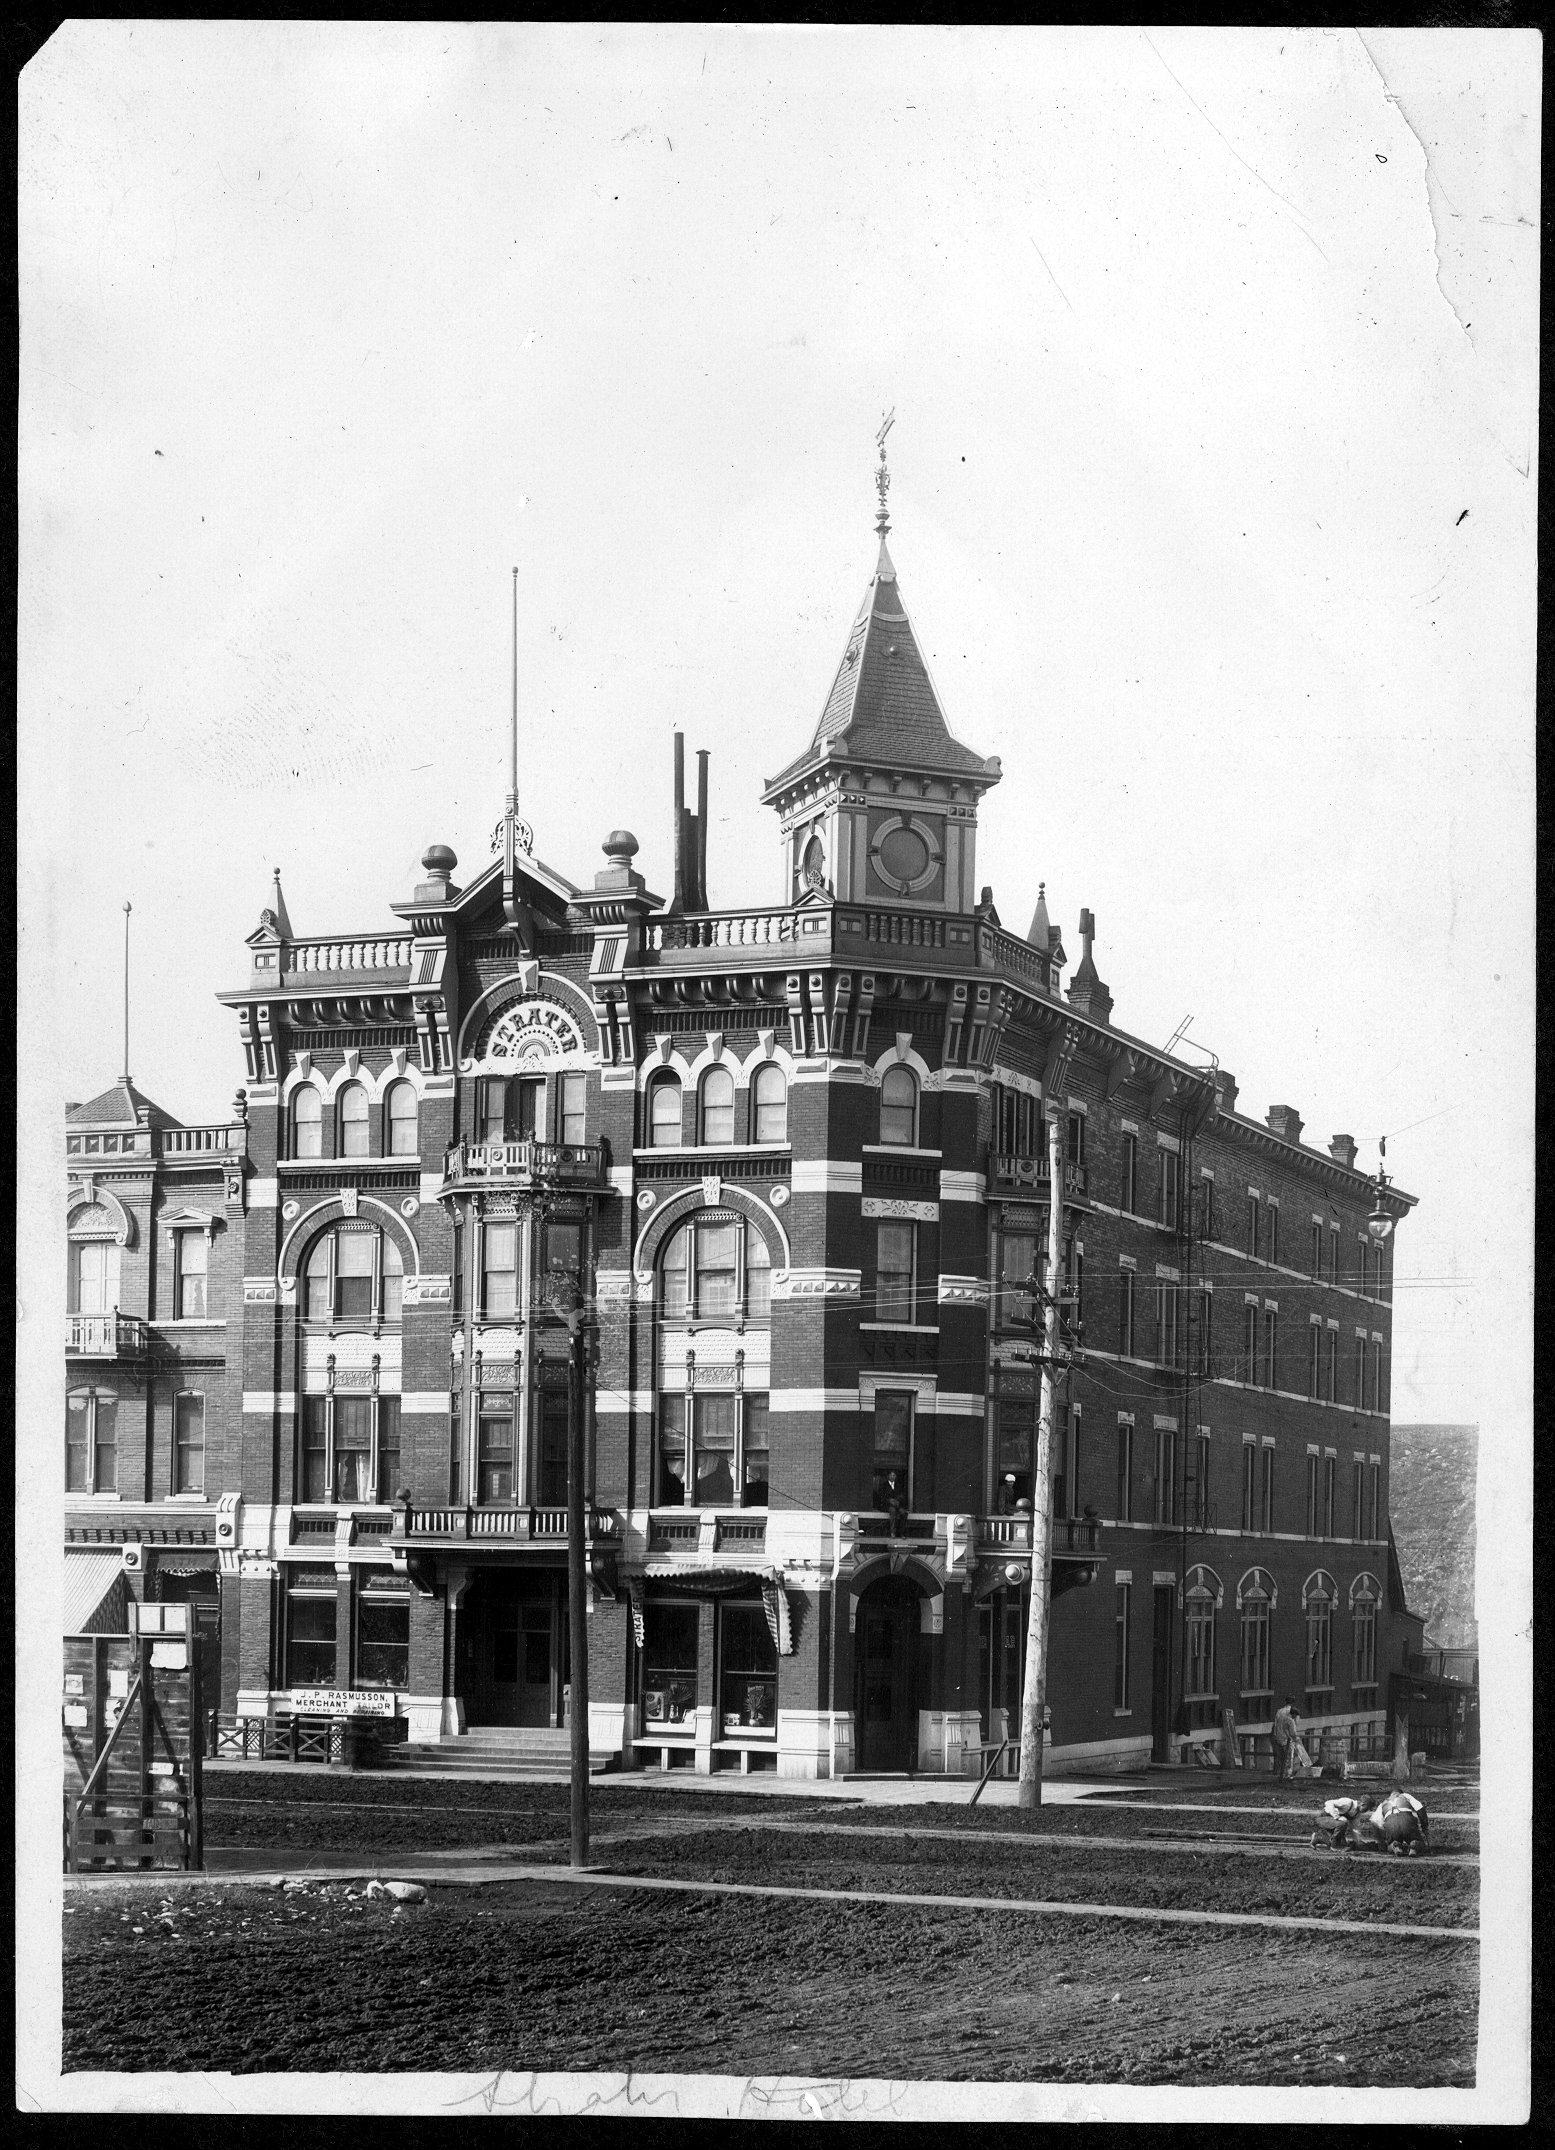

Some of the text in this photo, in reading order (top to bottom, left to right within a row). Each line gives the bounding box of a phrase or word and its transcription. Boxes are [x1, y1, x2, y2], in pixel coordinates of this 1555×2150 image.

[491, 1008, 578, 1057] STRATER
[314, 1691, 325, 1699] P.
[296, 1699, 348, 1708] MERCHANT
